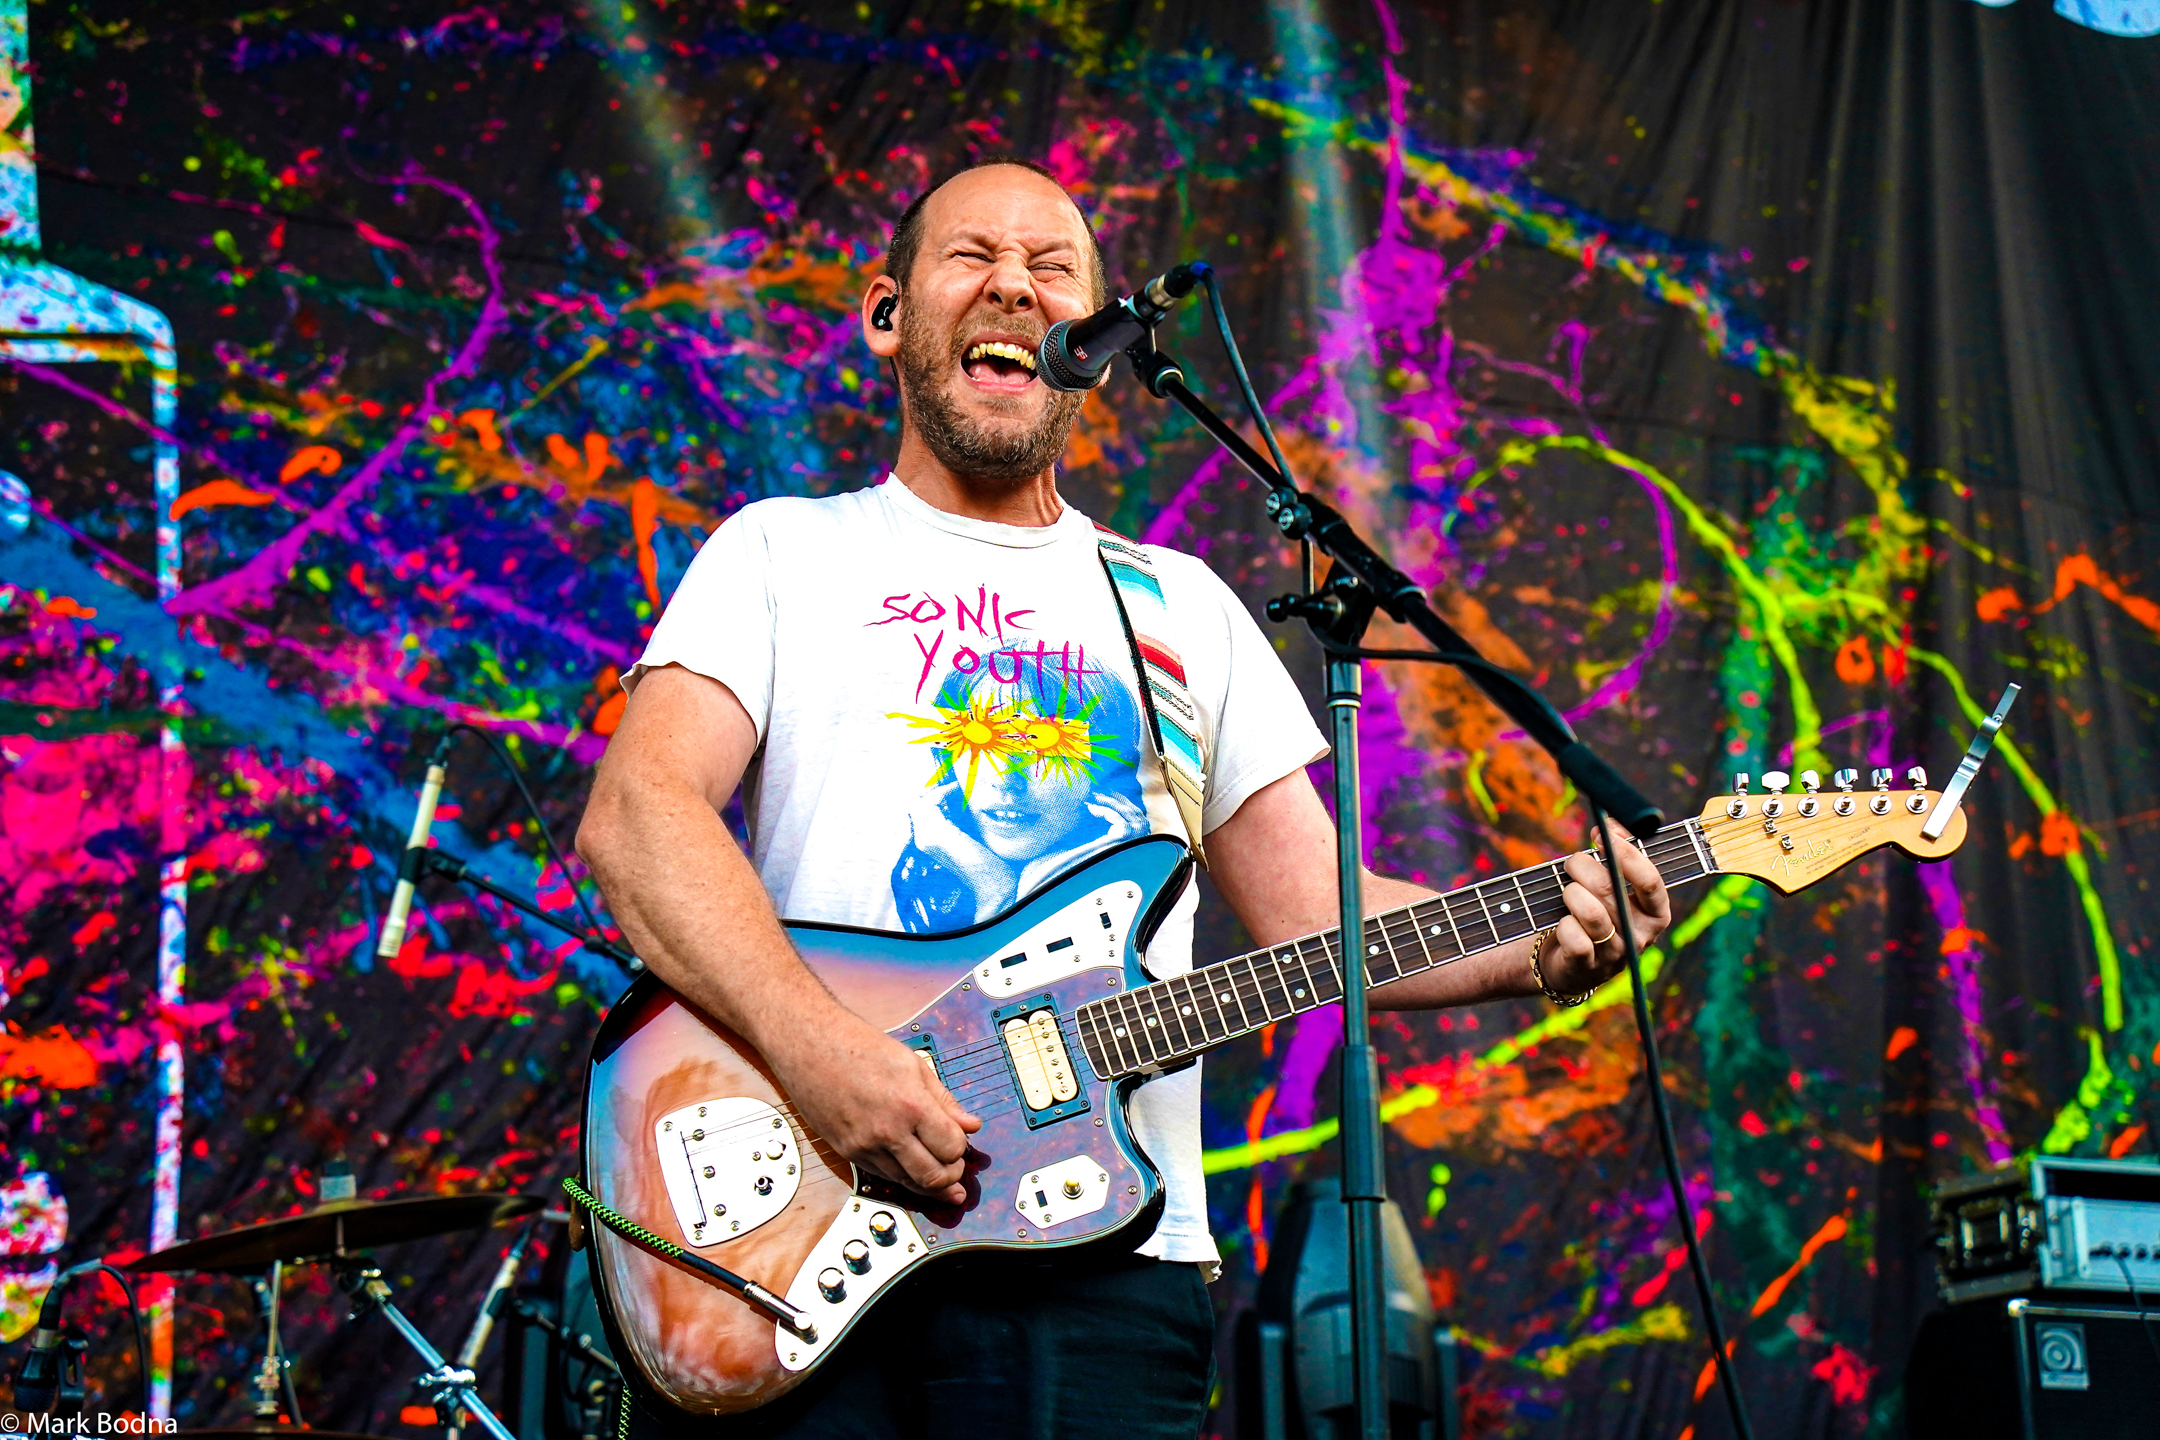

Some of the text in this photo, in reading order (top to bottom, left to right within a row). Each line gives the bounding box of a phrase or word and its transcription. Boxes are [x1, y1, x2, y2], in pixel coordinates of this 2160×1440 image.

[862, 582, 1036, 649] SONIC
[913, 629, 1104, 705] YOUTH
[1771, 839, 1833, 876] Fender
